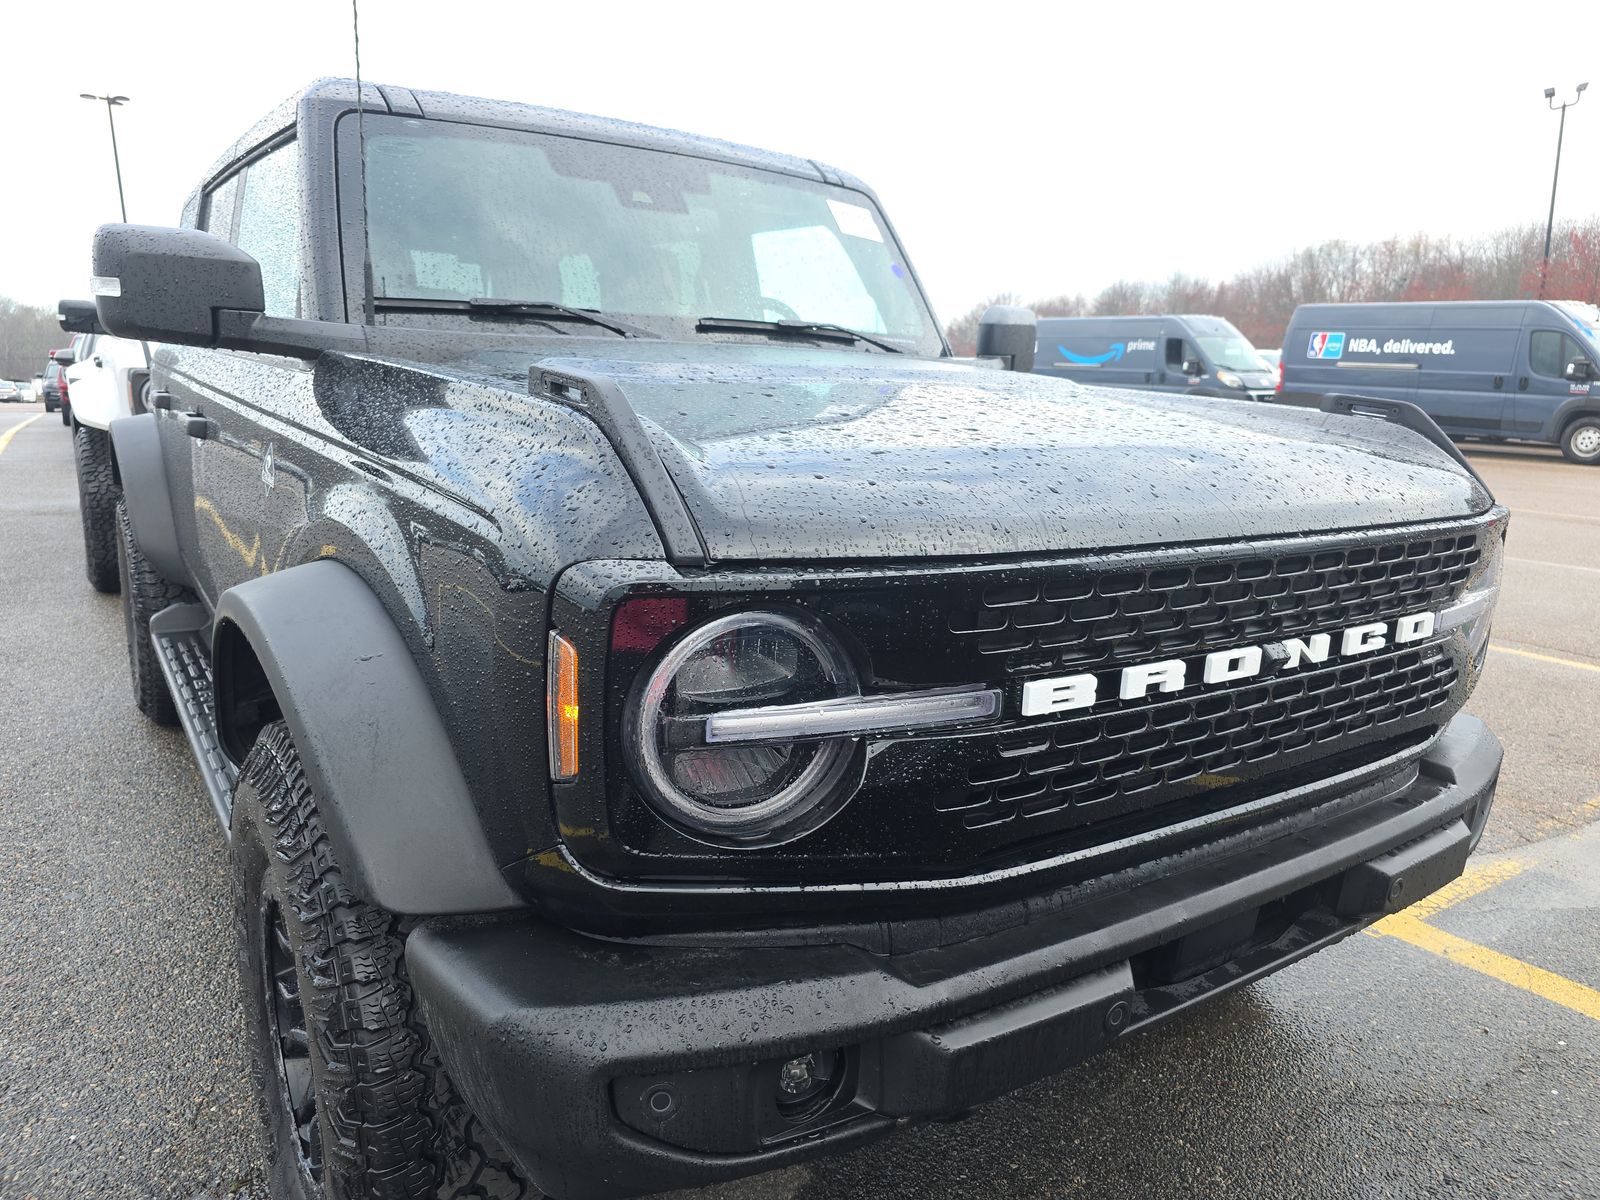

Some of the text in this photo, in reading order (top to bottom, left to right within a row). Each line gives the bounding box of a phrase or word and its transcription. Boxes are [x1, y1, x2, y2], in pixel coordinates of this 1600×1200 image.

[1126, 338, 1156, 353] prime
[1348, 338, 1455, 355] NBA, delivered.
[1021, 611, 1435, 717] BRONCO
